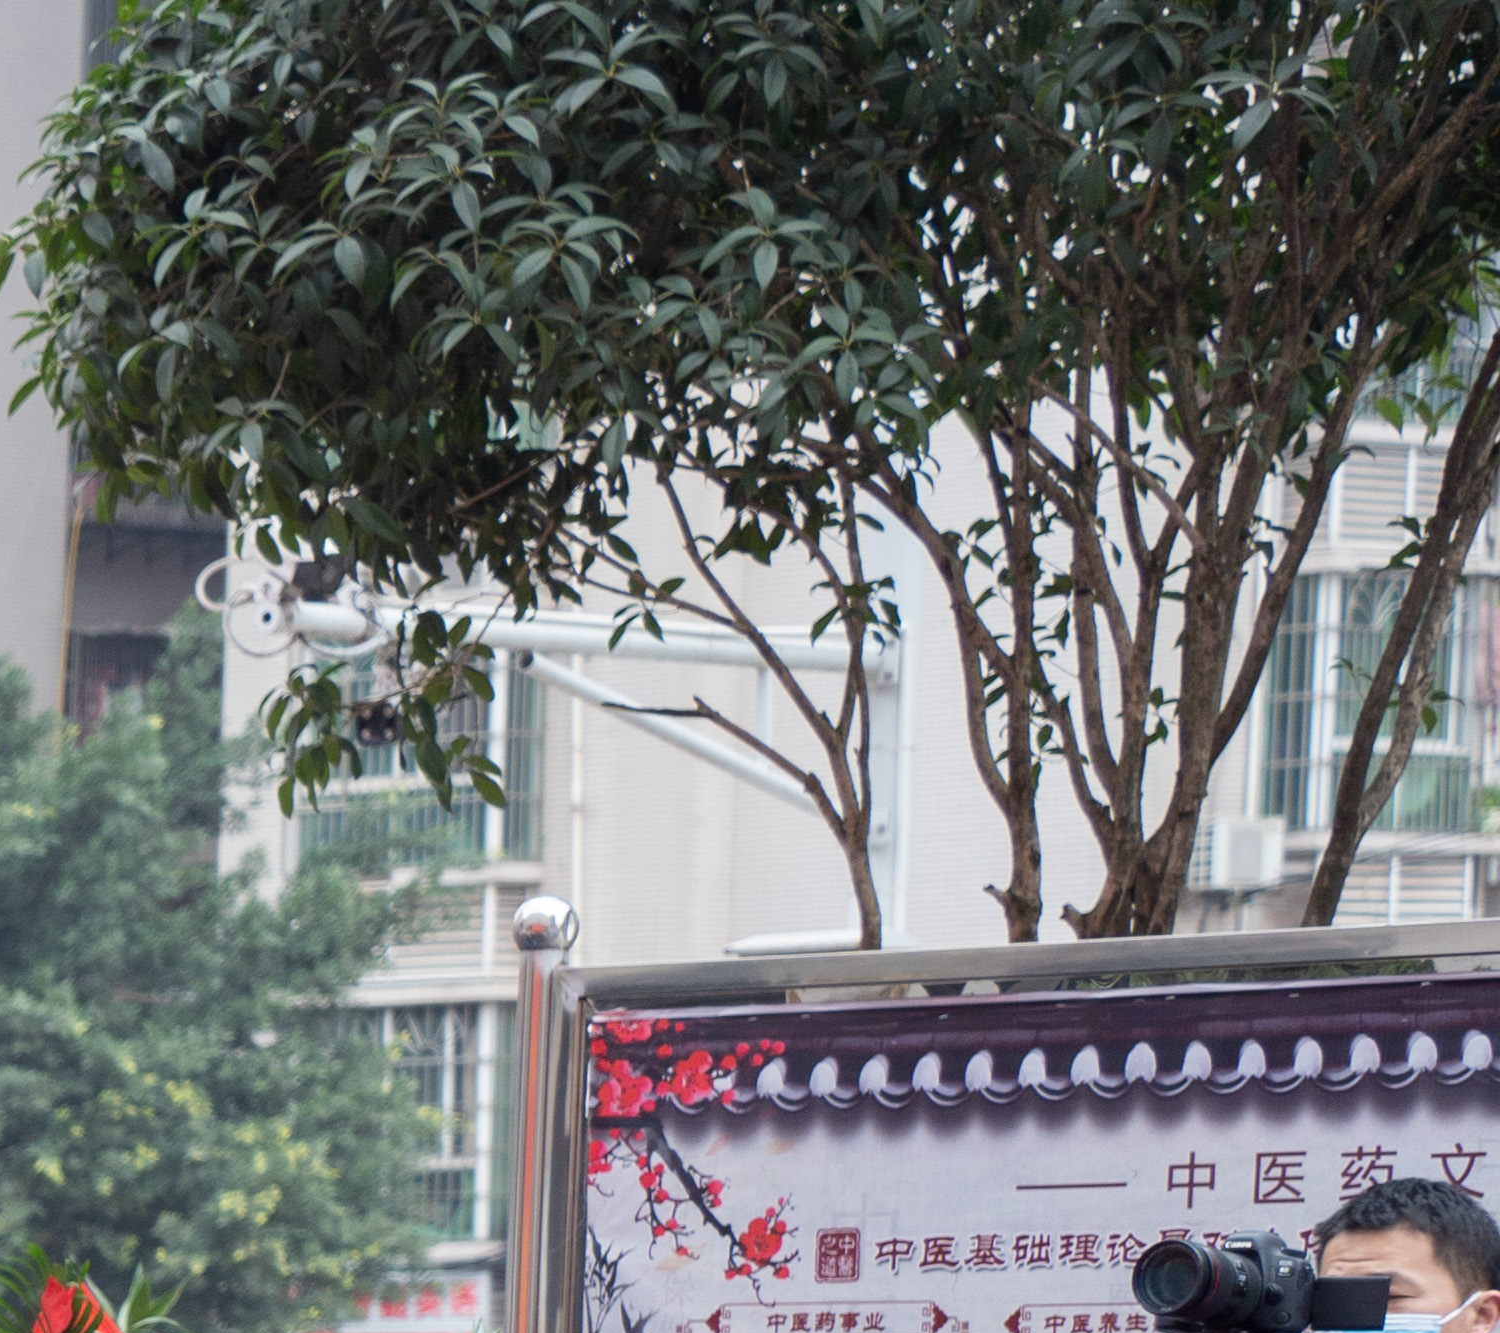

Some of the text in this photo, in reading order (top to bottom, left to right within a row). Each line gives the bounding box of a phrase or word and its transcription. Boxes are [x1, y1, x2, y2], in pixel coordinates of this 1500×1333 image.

[1224, 1240, 1253, 1250] Canon
[766, 1311, 886, 1333] 中医药事业
